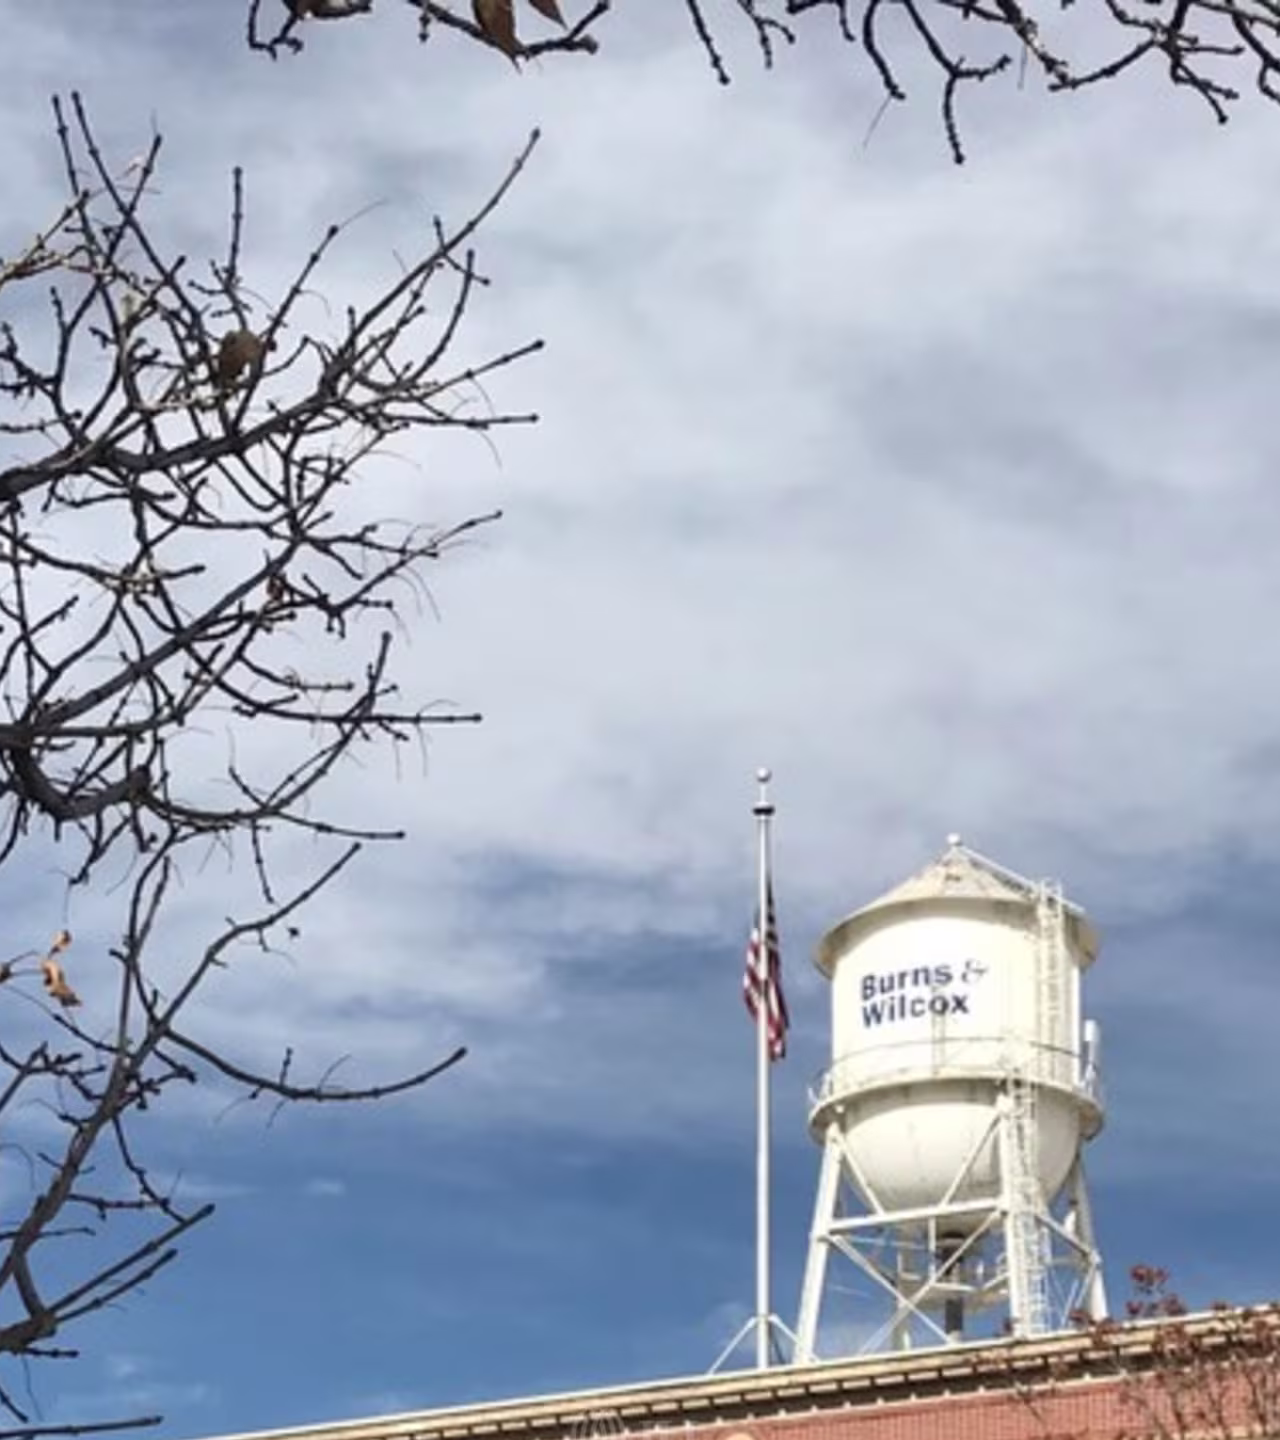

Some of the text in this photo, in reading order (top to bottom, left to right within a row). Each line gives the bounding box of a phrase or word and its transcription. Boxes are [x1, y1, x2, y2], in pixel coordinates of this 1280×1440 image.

[861, 958, 988, 1001] Burns &
[862, 993, 970, 1028] Wilcox
